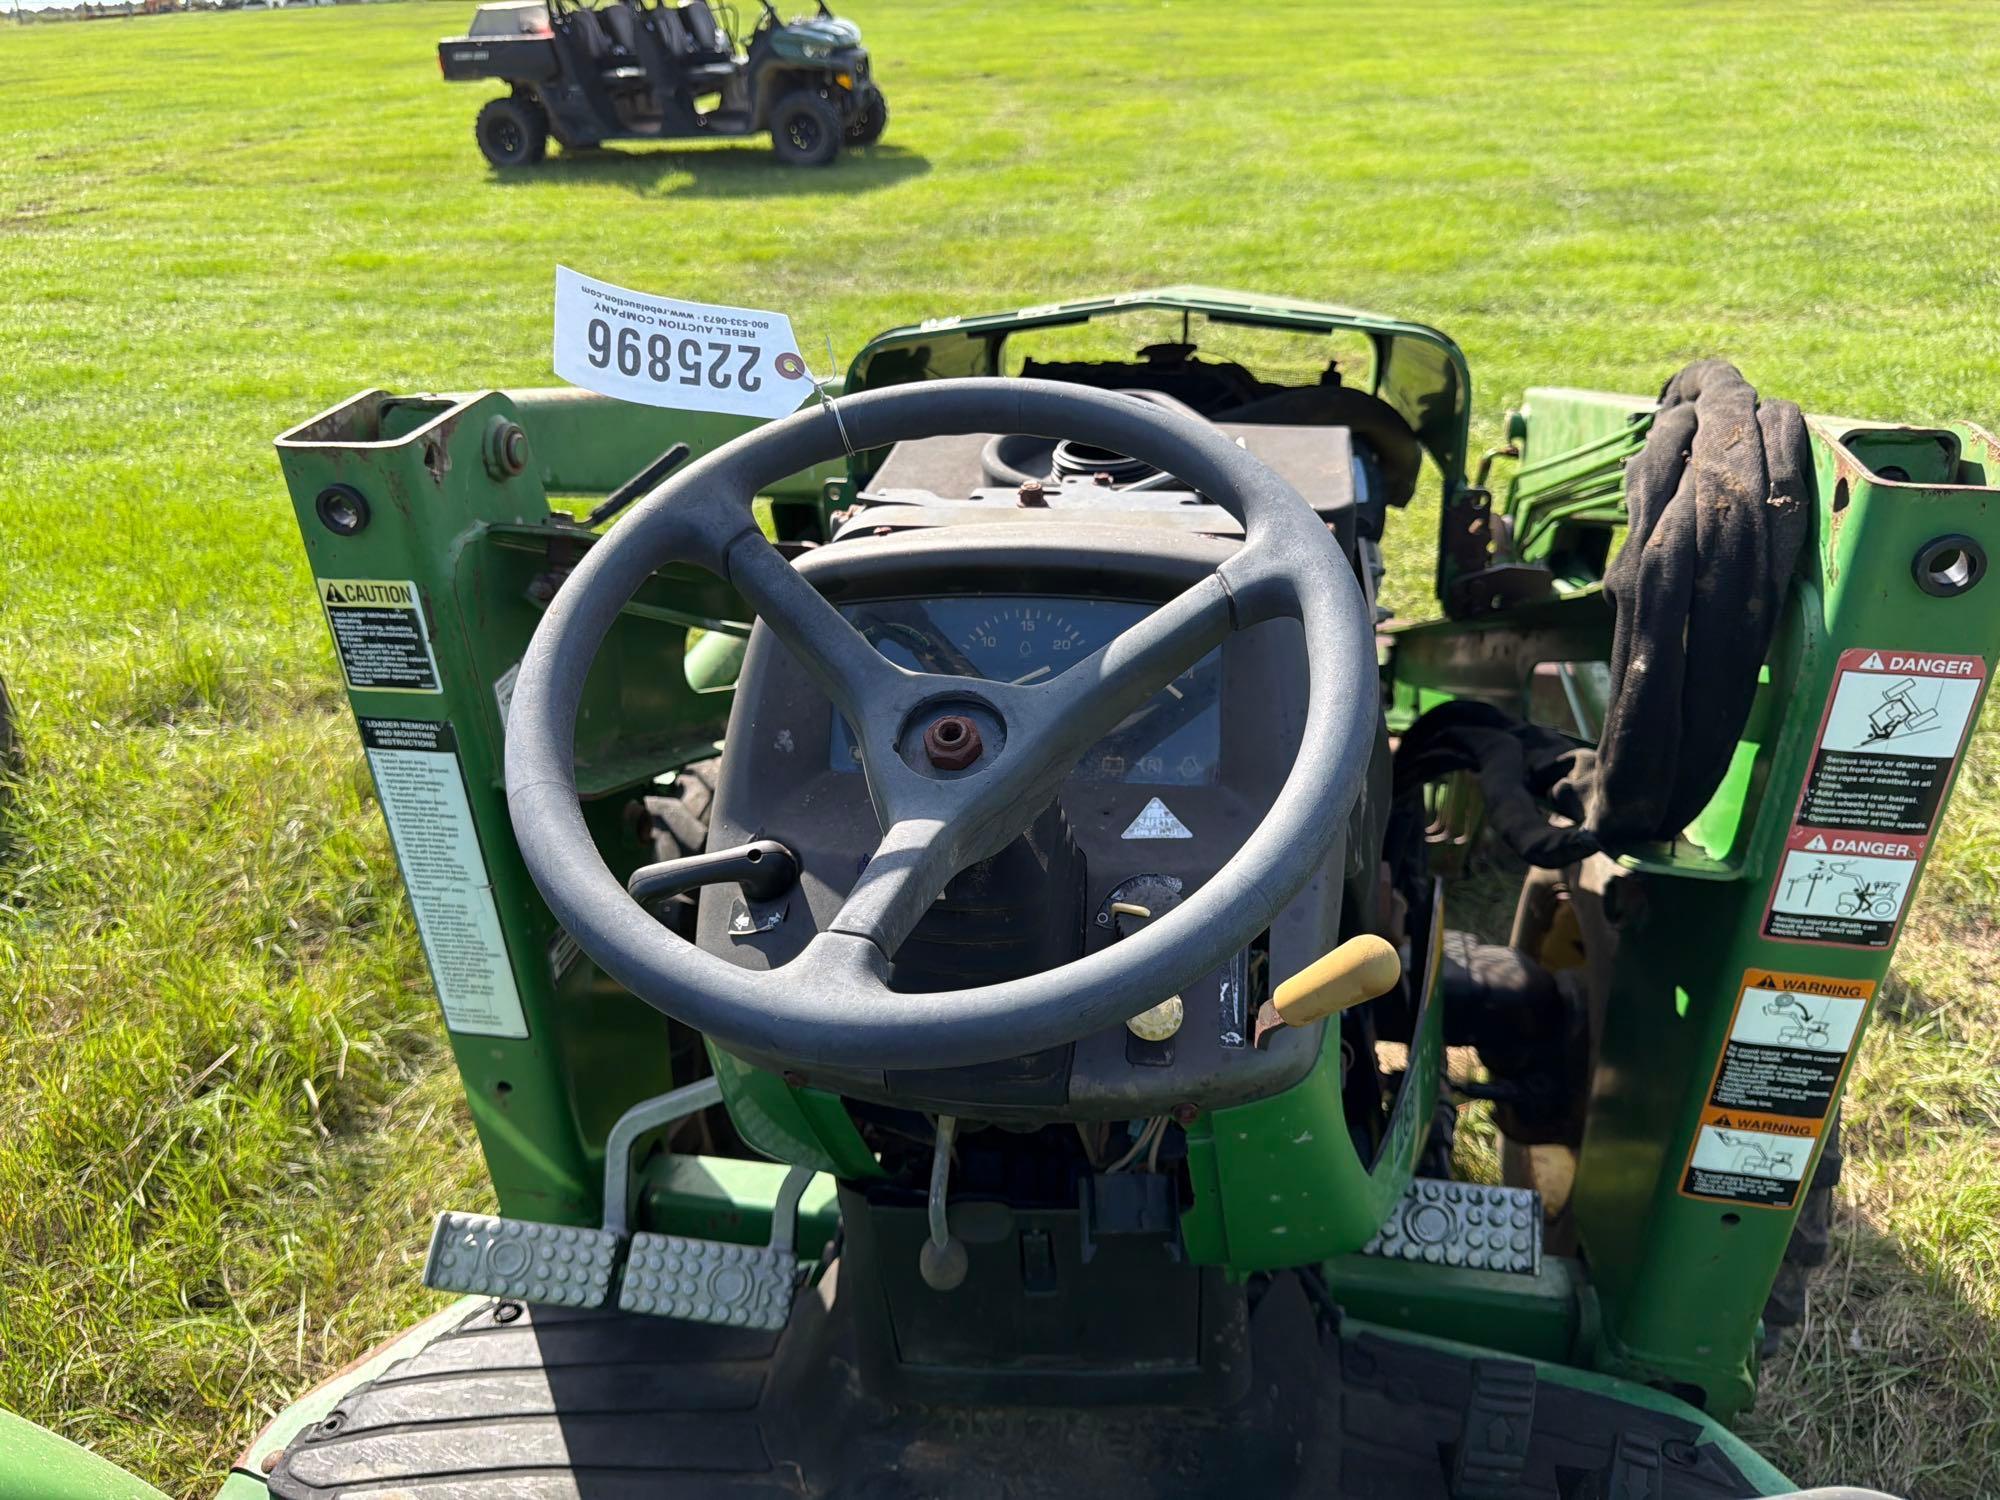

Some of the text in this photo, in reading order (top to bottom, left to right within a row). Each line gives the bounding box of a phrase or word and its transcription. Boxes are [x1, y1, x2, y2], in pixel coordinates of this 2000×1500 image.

[581, 285, 770, 330] 800-533-0673 www.rebelauction.com
[593, 302, 757, 339] REBEL AUCTION COMPANY
[587, 318, 762, 393] 225896
[345, 584, 413, 603] CAUTION
[1021, 621, 1035, 631] 15
[981, 636, 1071, 650] 10 20
[1889, 657, 1973, 674] DANGER
[400, 722, 441, 731] REMOVAL
[394, 731, 436, 739] MOUNTING
[379, 738, 437, 748] INSTRUCTIONS
[1826, 756, 1858, 765] Serious
[1859, 759, 1883, 768] injury
[1896, 761, 1920, 769] death
[1823, 765, 1847, 773] result
[1870, 768, 1908, 777] rollovers.
[1839, 775, 1858, 783] rops
[1877, 777, 1910, 786] seatbelt
[1813, 798, 1836, 806] Move
[1837, 800, 1865, 808] wheels
[1877, 803, 1904, 811] widest
[1834, 792, 1869, 800] required
[1889, 795, 1918, 804] ballast.
[1808, 813, 1840, 823] Operate
[1842, 816, 1869, 824] tractor
[1880, 819, 1895, 827] low
[1897, 820, 1927, 829] speeds.
[1831, 838, 1910, 857] DANGER
[1806, 919, 1827, 927] injury
[1839, 921, 1861, 930] death
[1815, 926, 1844, 934] contact
[1782, 979, 1861, 997] WARNING
[1737, 1119, 1811, 1136] WARNING
